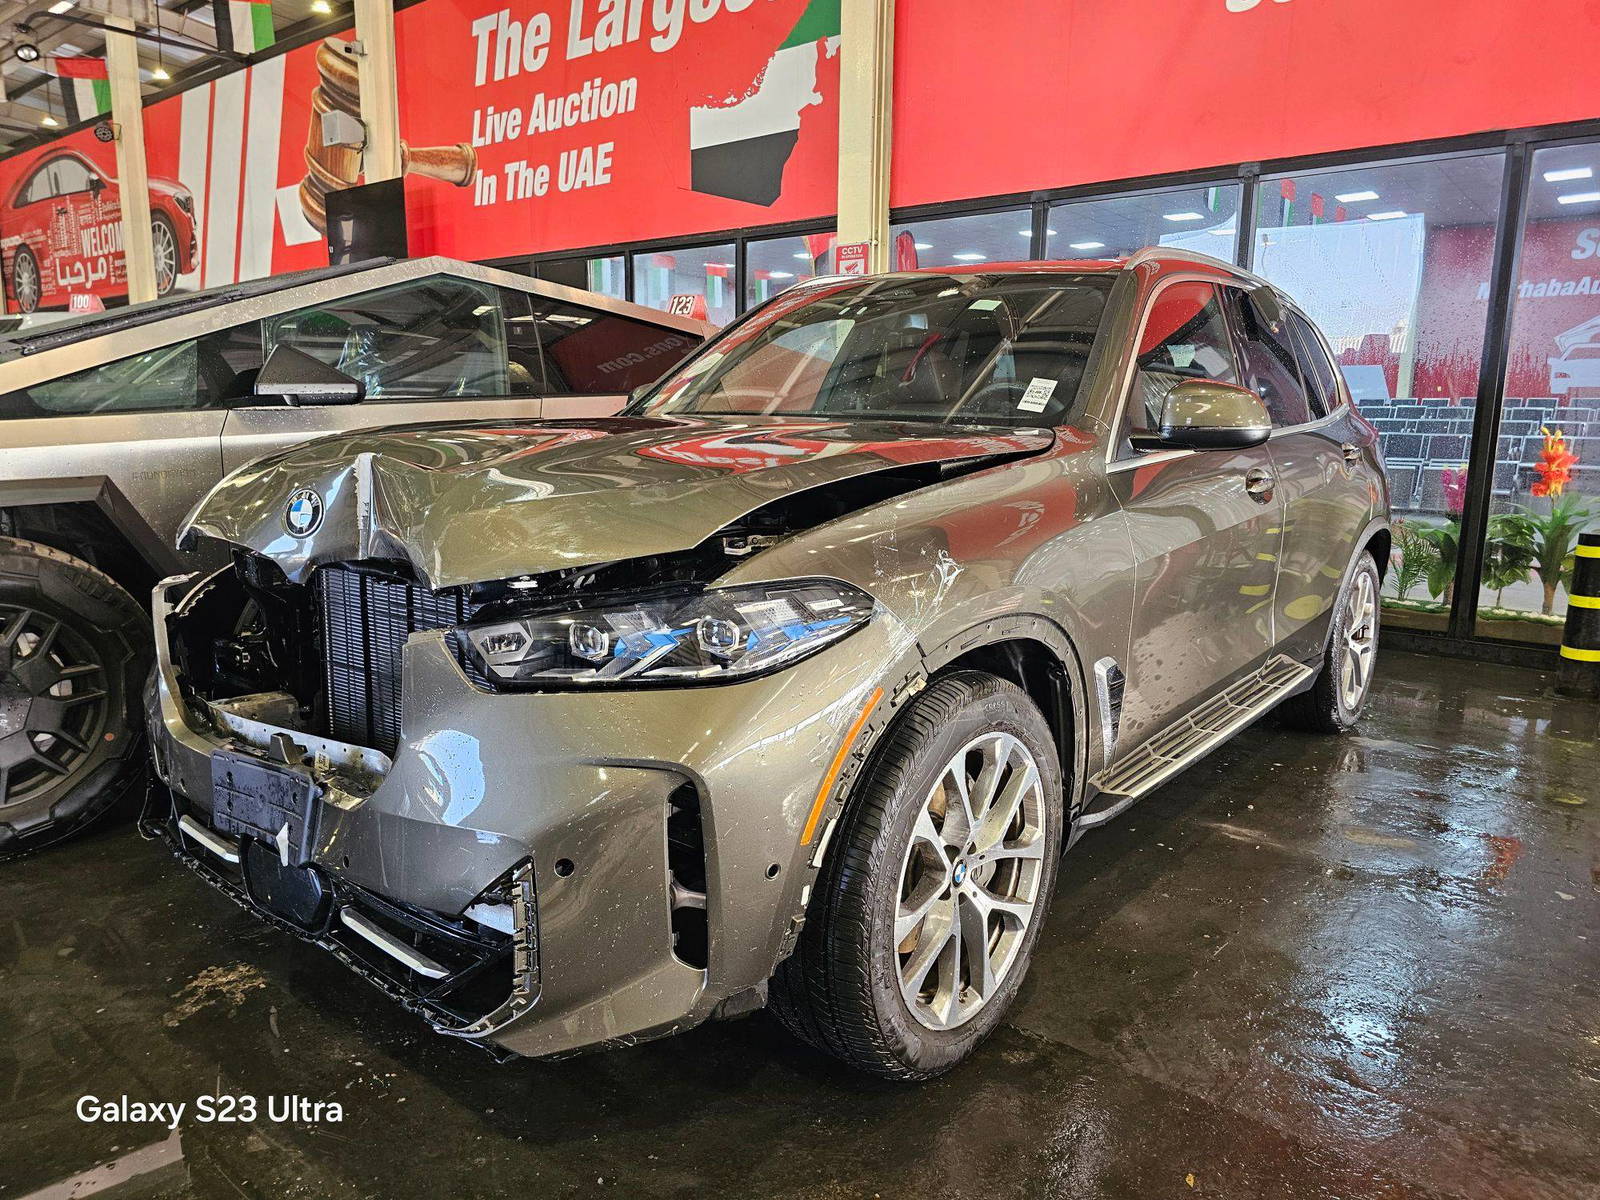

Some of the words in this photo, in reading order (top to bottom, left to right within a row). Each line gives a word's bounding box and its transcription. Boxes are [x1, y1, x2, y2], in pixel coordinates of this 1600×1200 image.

[472, 9, 550, 87] The
[566, 0, 777, 60] Larg
[472, 106, 521, 147] Live
[527, 77, 637, 136] Auction
[474, 169, 497, 206] In
[505, 160, 549, 201] The
[557, 142, 614, 192] UAE
[81, 220, 125, 258] WELCOM
[841, 246, 863, 255] CCTV
[56, 257, 107, 292] مرحبا
[73, 295, 89, 308] 100
[671, 296, 694, 315] 123
